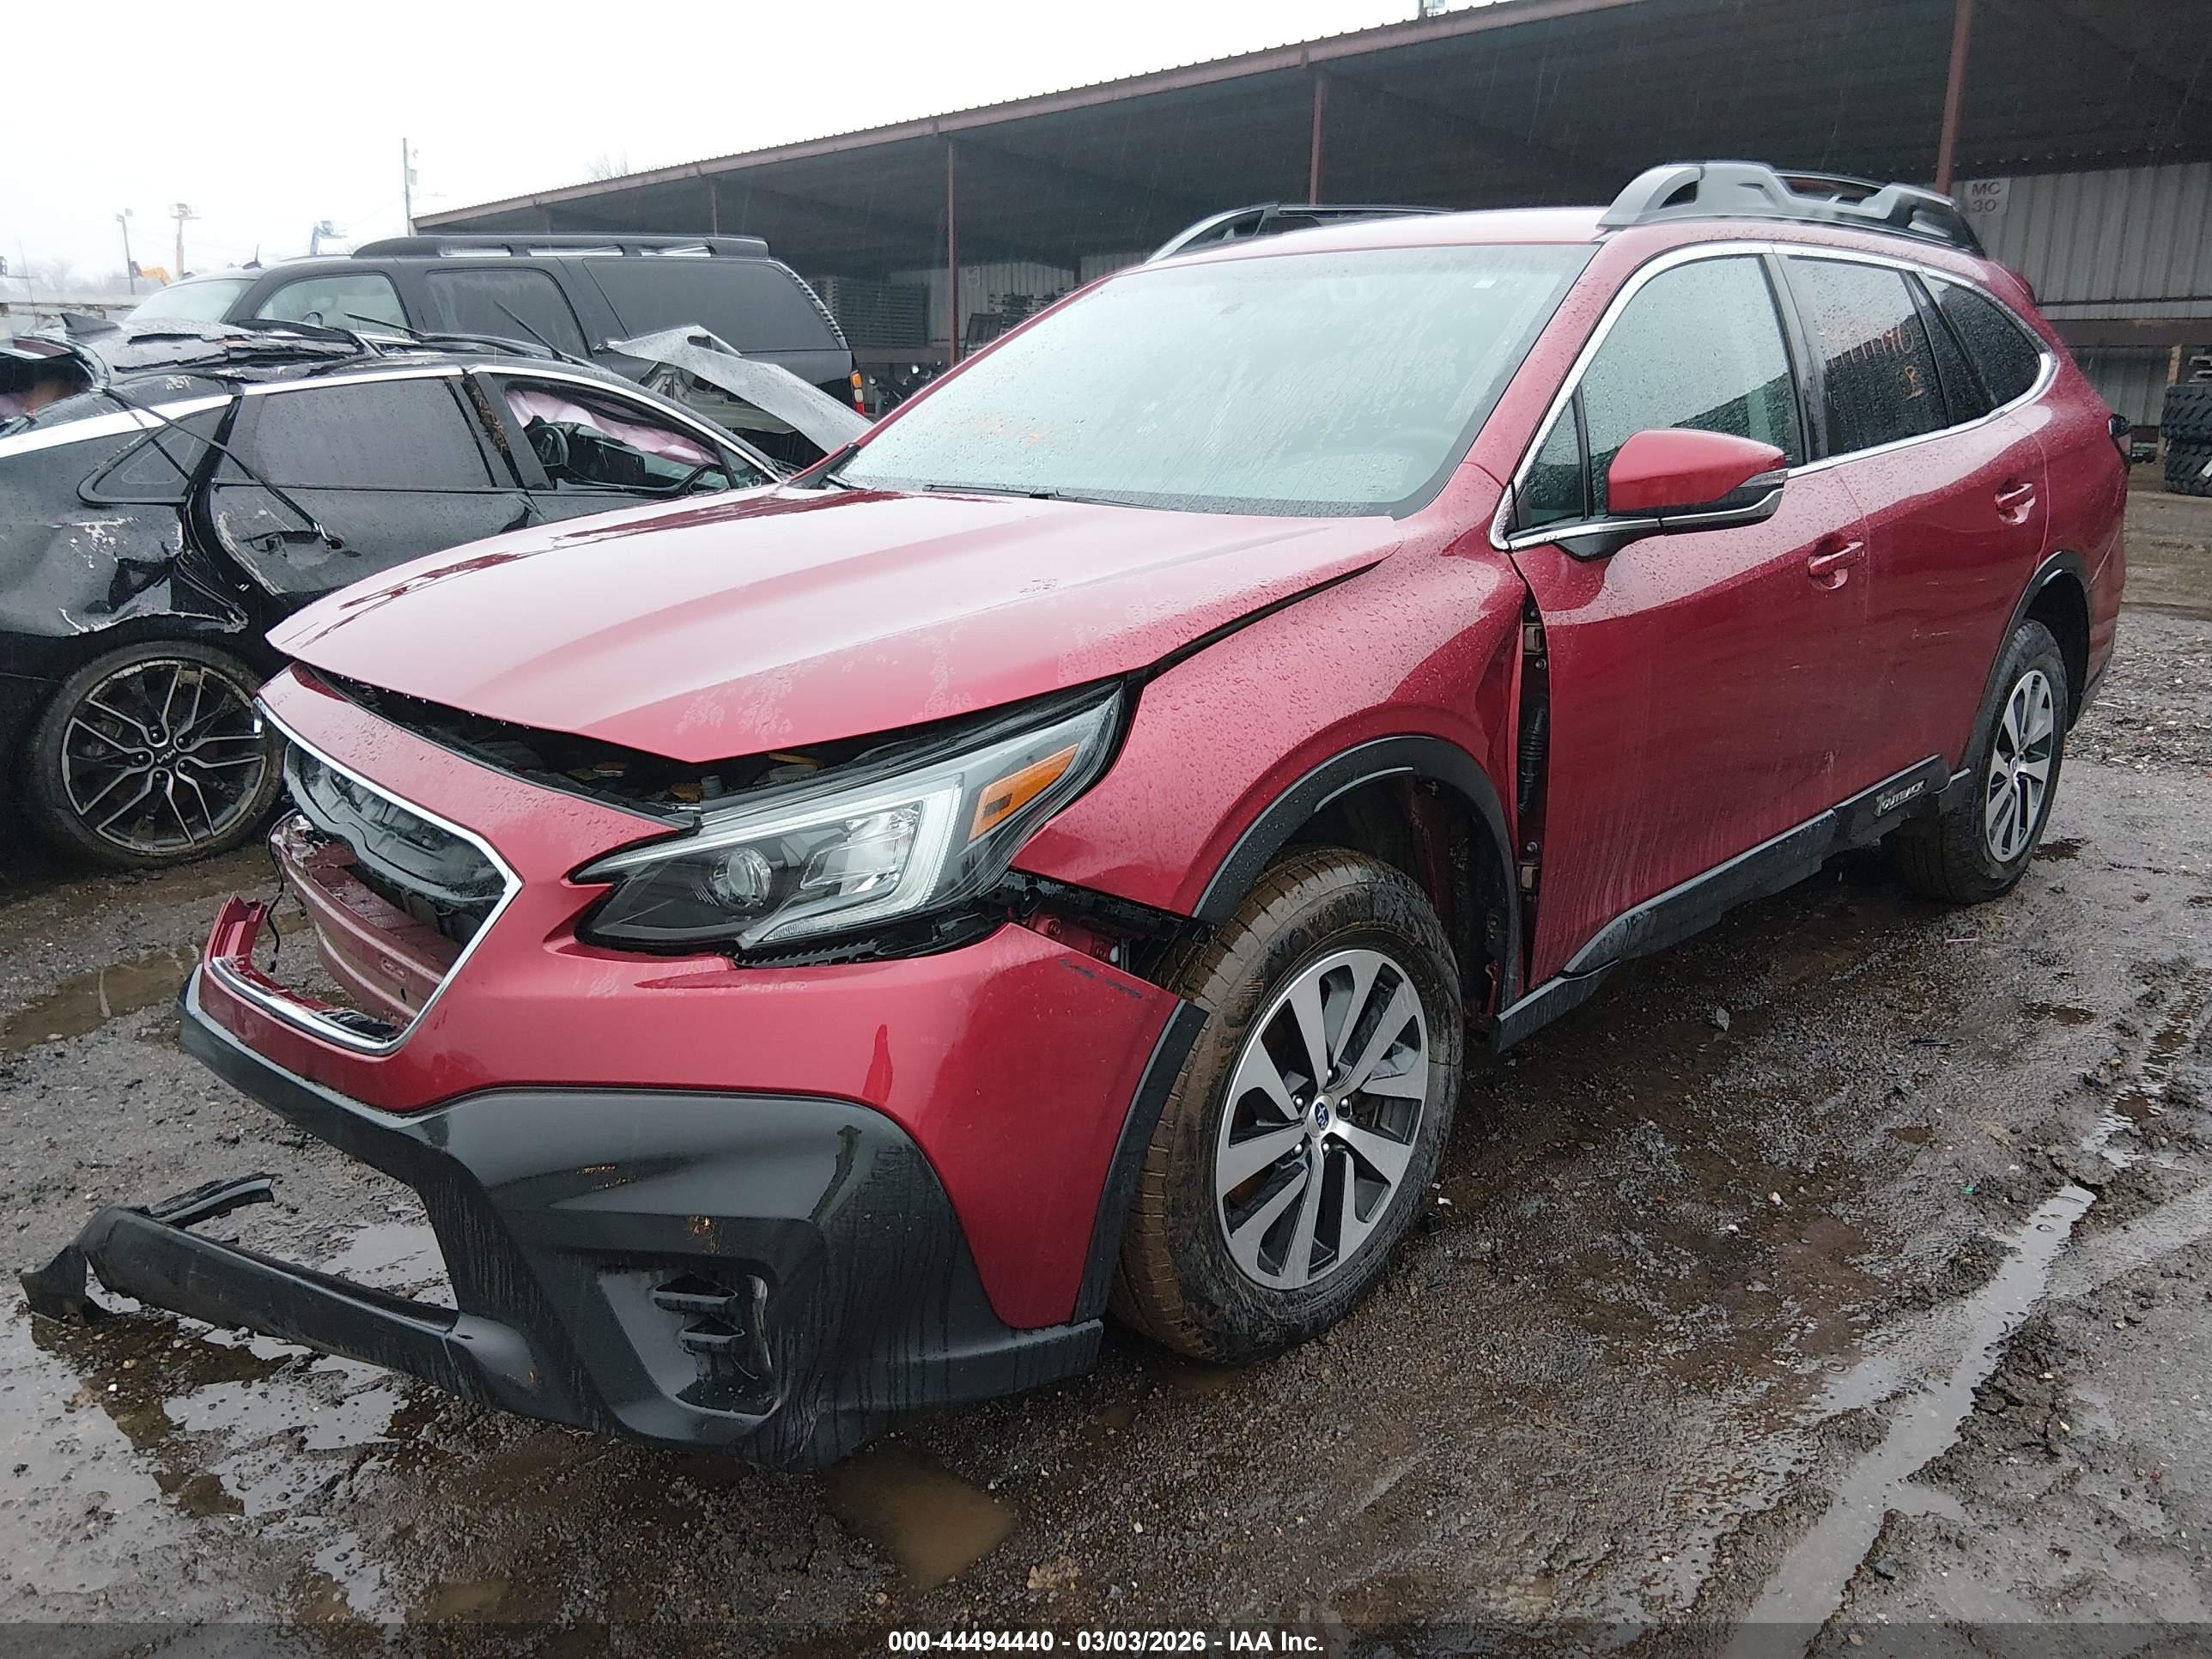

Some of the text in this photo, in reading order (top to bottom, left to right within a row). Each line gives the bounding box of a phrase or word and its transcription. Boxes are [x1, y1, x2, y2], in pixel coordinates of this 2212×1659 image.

[1972, 181, 2002, 197] MC
[1972, 198, 1998, 213] 30
[1881, 779, 1925, 810] OUTBACK
